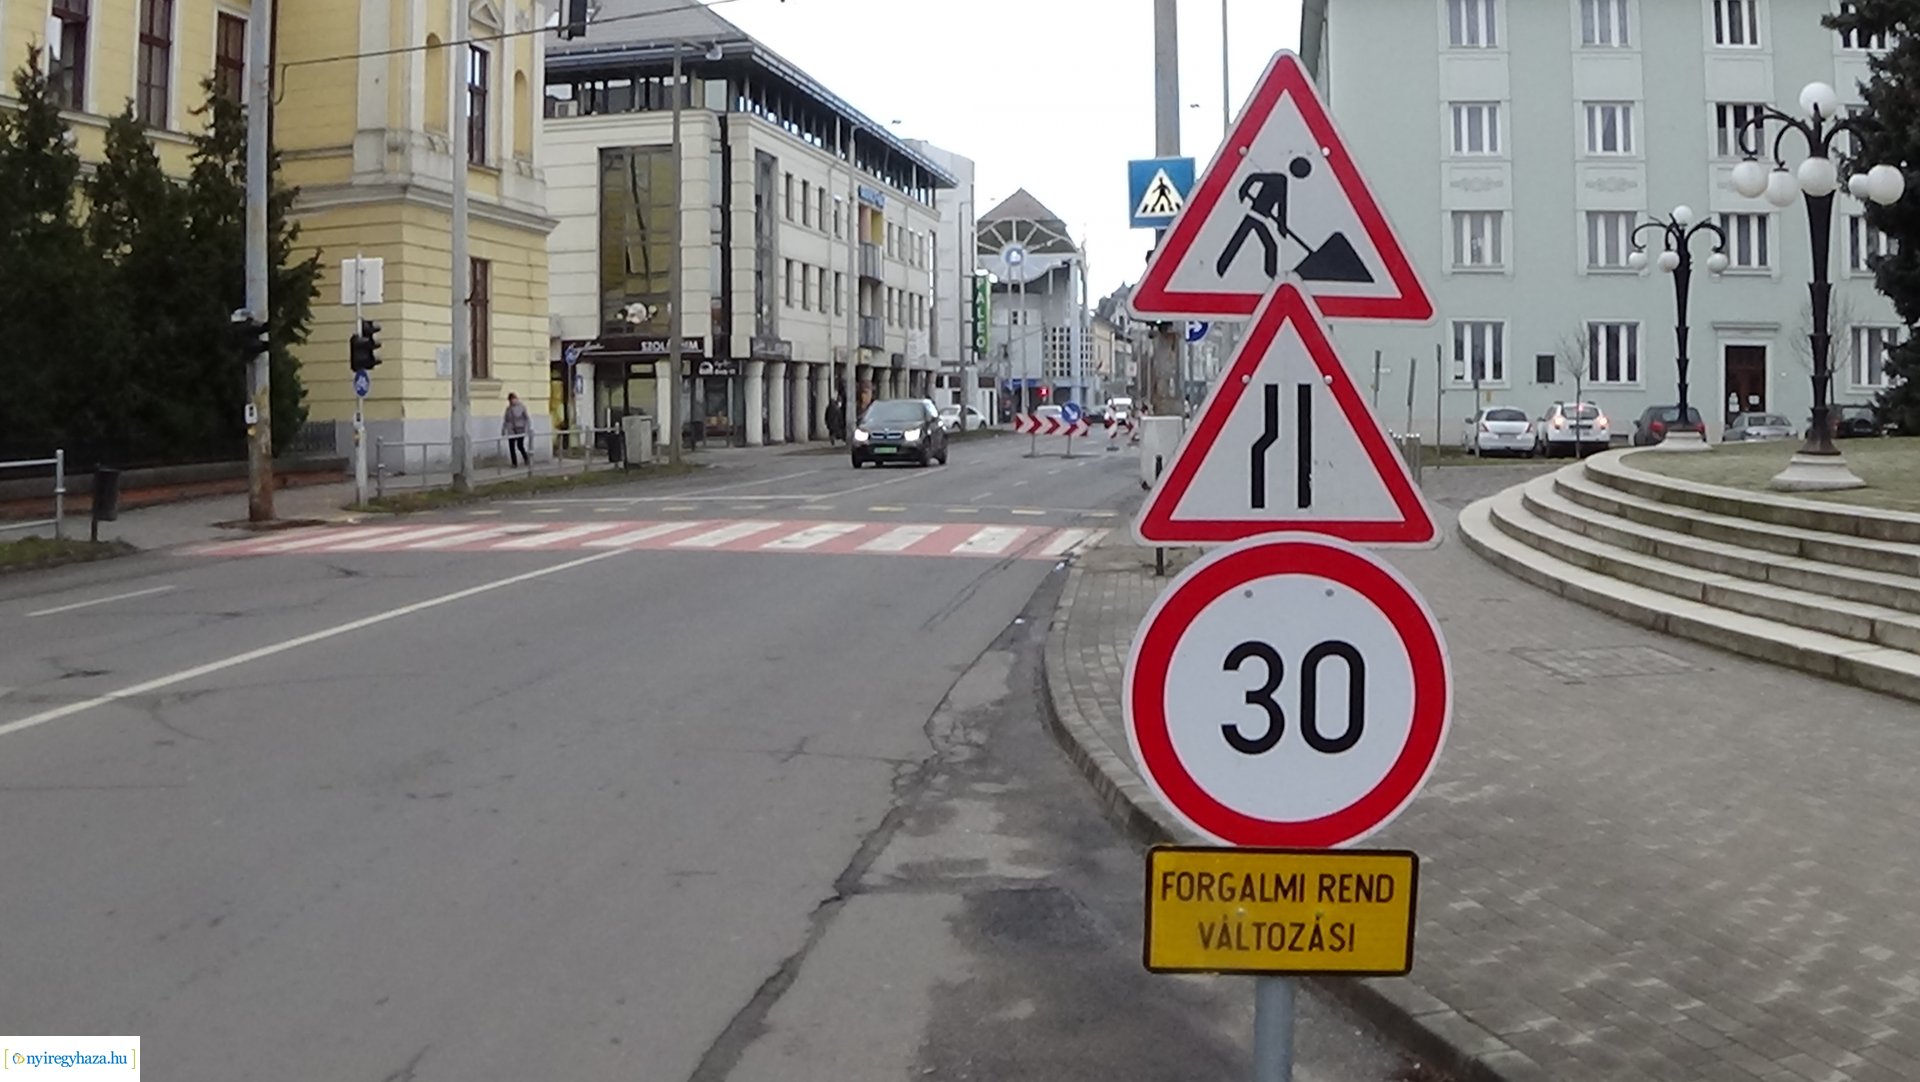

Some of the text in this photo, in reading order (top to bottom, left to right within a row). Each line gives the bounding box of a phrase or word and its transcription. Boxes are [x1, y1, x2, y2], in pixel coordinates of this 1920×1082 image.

[976, 277, 986, 348] PALEO
[1221, 640, 1365, 755] 30
[1162, 871, 1394, 903] FORGALMI REND
[1198, 914, 1355, 952] VÁLTOZÁSI
